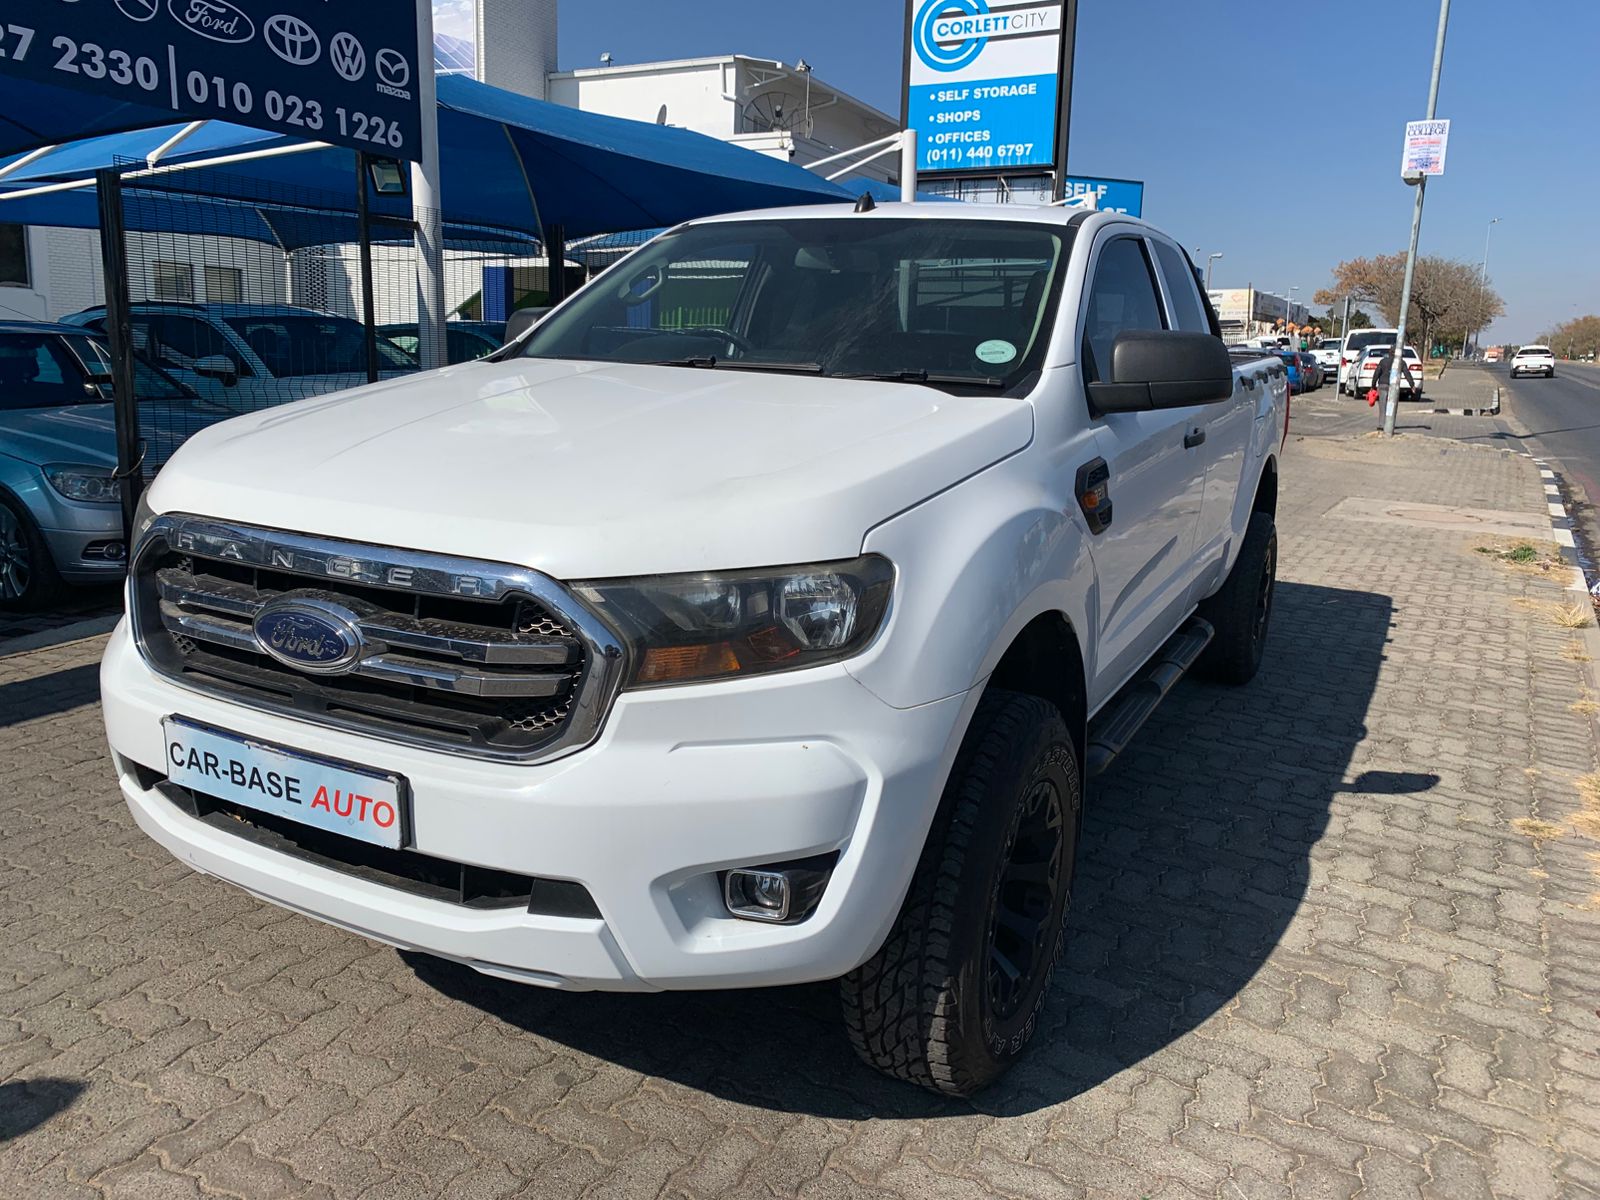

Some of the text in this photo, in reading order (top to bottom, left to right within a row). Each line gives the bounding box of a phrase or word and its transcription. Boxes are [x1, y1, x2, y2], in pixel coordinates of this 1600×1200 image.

[184, 0, 240, 37] Ford
[0, 24, 159, 91] 7 2330
[376, 83, 411, 100] mazda
[937, 83, 1037, 102] SELF STORAGE
[187, 70, 403, 148] 010 023 1226
[936, 110, 981, 124] SHOPS
[935, 130, 991, 144] OFFICES
[1407, 128, 1447, 136] COLLEGE
[926, 143, 1034, 163] (011) 440 6797
[177, 532, 481, 596] RANGER
[271, 617, 325, 657] Ford
[169, 741, 395, 829] CAR-BASE AUTO
